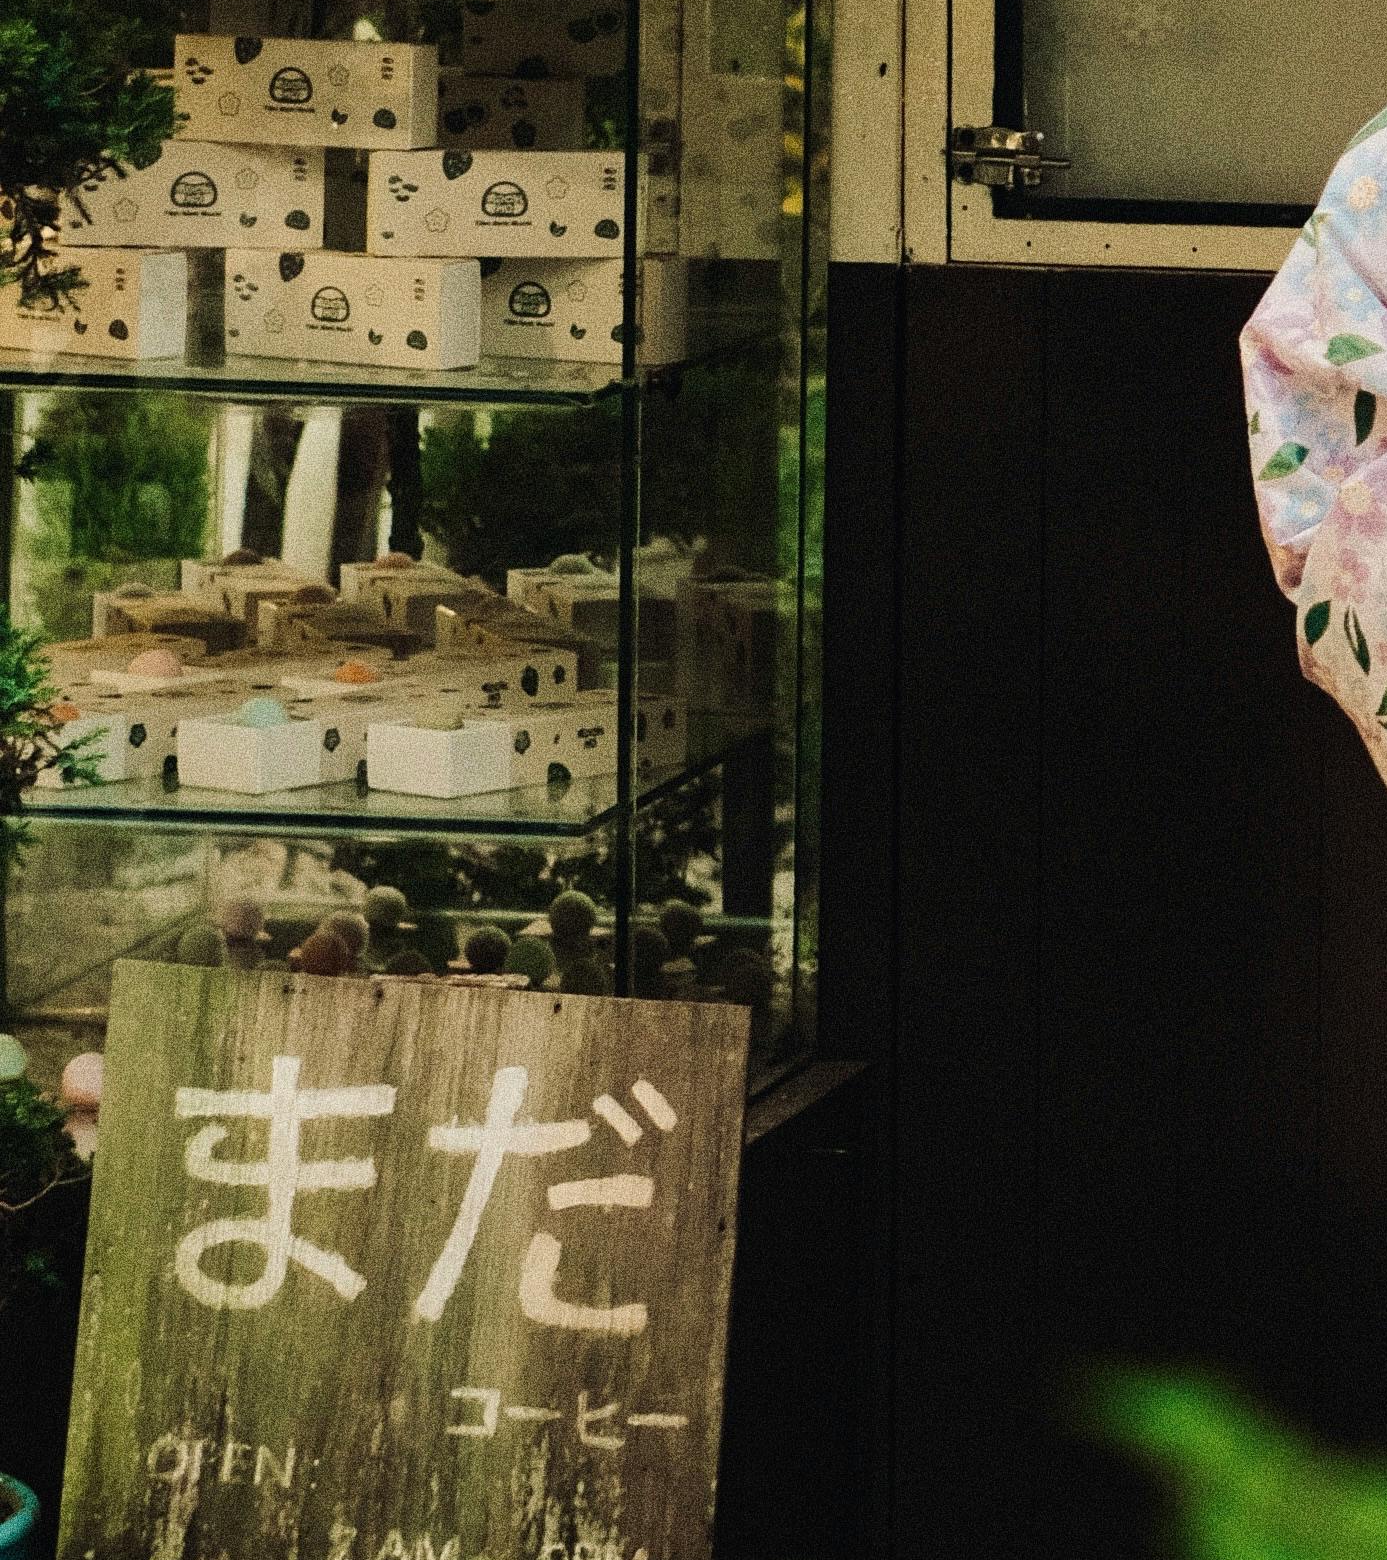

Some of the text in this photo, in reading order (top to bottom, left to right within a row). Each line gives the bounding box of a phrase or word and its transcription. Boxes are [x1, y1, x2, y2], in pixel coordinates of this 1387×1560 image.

[175, 1054, 680, 1336] まだ
[445, 1386, 689, 1450] コーヒー
